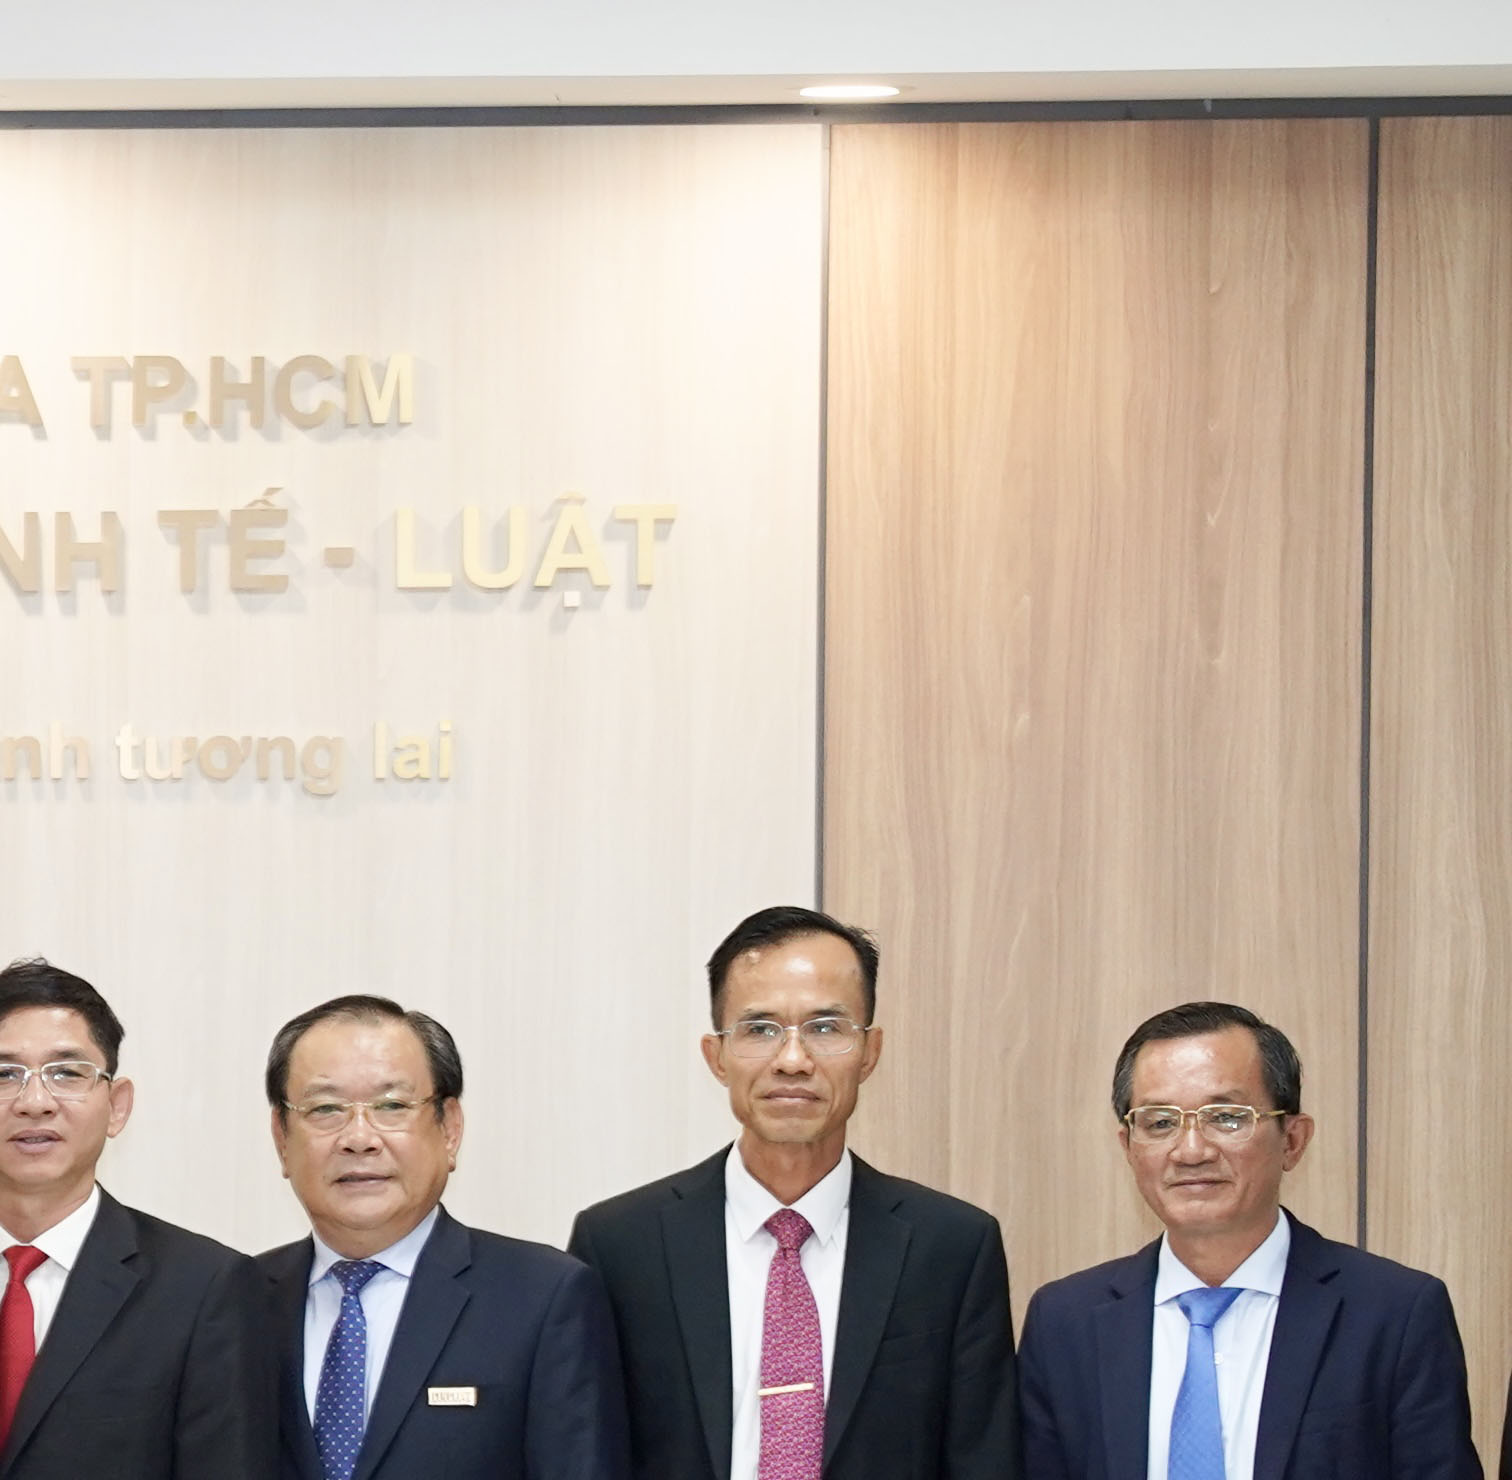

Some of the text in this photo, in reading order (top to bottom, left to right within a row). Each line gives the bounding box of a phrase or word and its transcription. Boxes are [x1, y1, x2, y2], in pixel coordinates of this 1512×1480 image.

[71, 353, 413, 428] TP.HCM
[158, 487, 289, 593] TẾ
[324, 548, 355, 568] -
[394, 491, 677, 608] LUẬT
[116, 724, 343, 795] tương
[373, 721, 453, 781] lai
